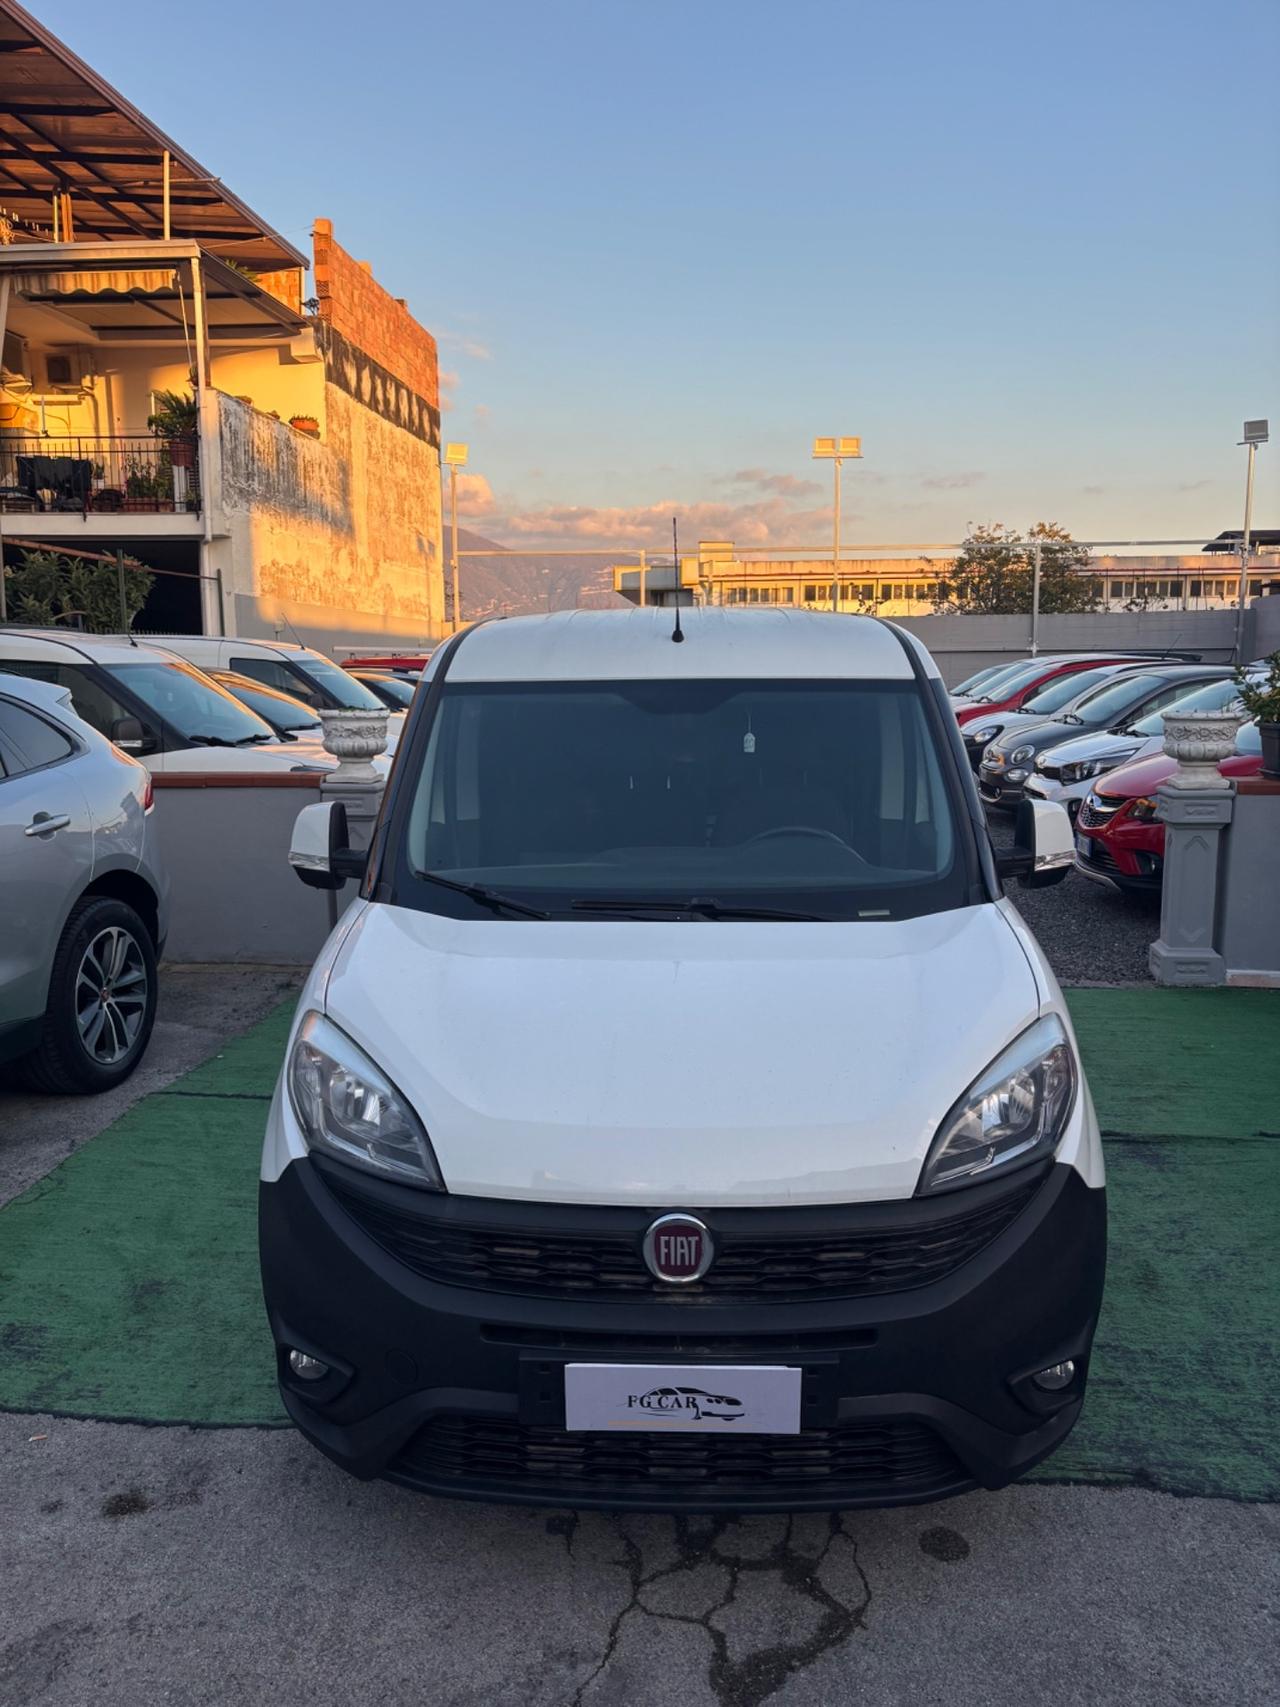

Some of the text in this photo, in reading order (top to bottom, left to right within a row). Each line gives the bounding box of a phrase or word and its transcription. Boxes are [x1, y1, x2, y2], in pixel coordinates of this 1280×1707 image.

[660, 1236, 699, 1266] FIAT
[627, 1395, 699, 1410] FG CAR
